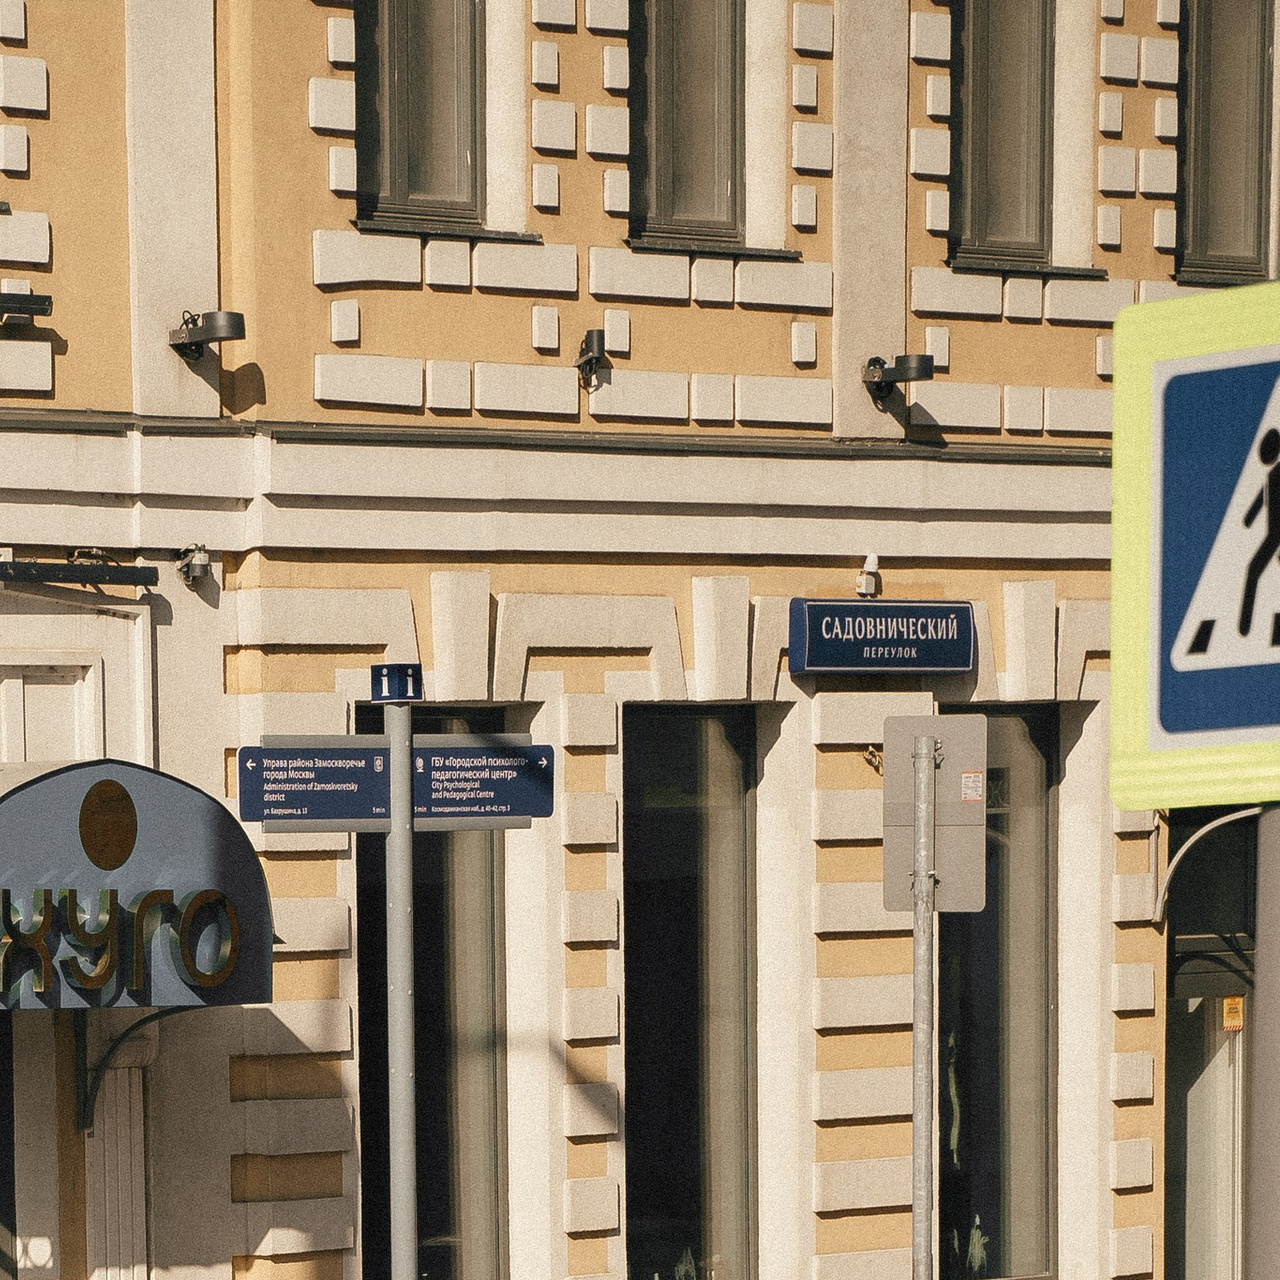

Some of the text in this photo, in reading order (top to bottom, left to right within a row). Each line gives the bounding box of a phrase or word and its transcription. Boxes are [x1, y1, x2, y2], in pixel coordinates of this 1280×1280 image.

[821, 613, 958, 642] САДОВНИЧЕСКИЙ
[863, 646, 917, 658] ПЕРЕУЛОК
[262, 758, 366, 770] Управа района Замоскворечье
[431, 756, 444, 767] ГБУ
[445, 756, 487, 769] «Городской
[263, 769, 315, 781] города Москвы
[431, 769, 517, 781] педагогический центр»
[263, 781, 358, 792] Administration of Zamoskvoretsky
[431, 780, 480, 791] City Psychological
[263, 793, 286, 801] district
[431, 790, 495, 800] and Pedagogical Centre
